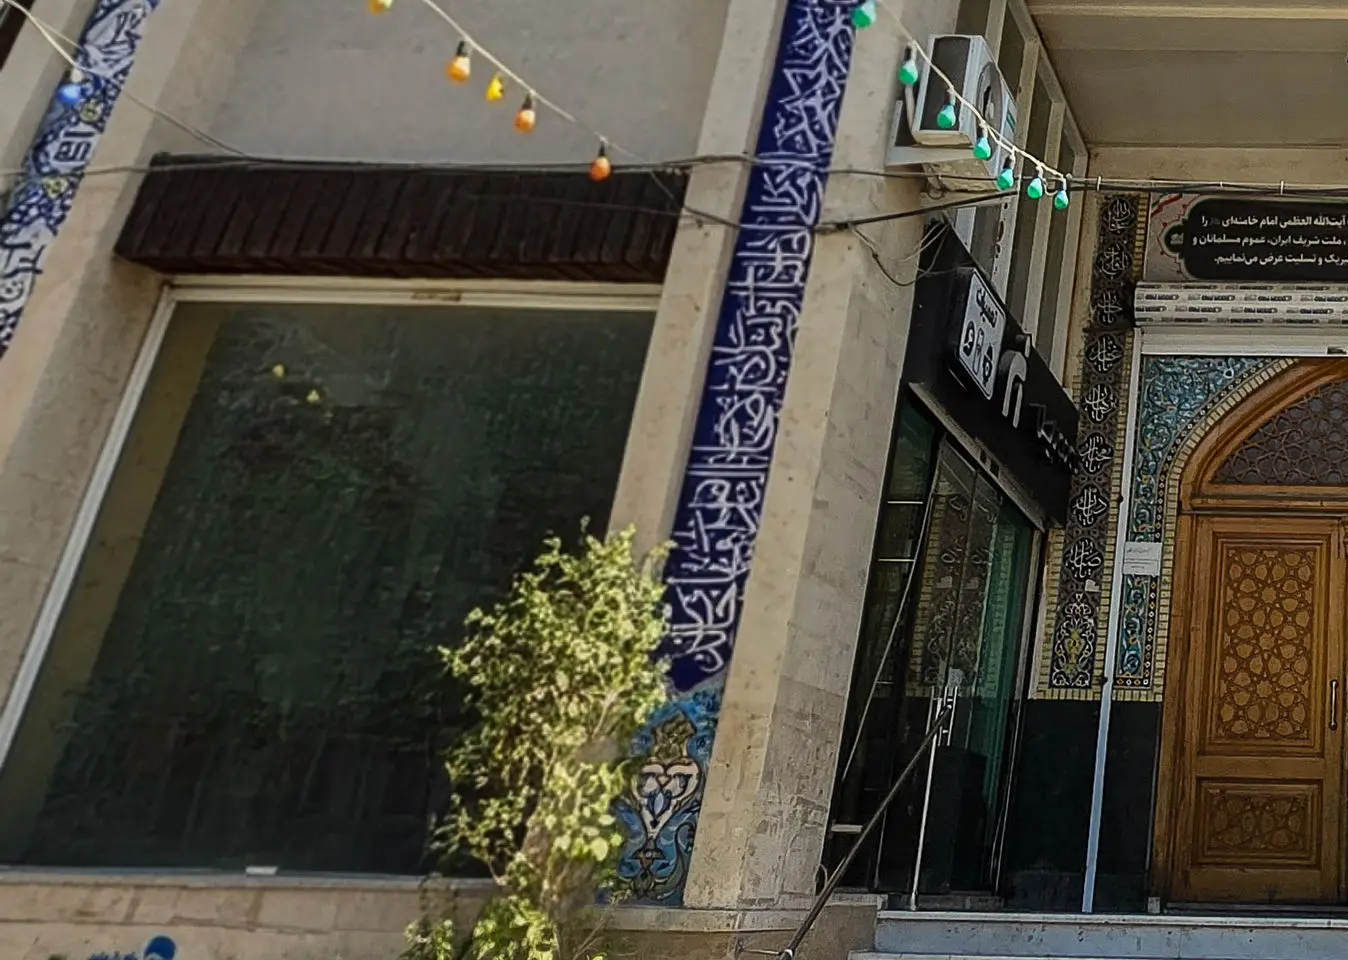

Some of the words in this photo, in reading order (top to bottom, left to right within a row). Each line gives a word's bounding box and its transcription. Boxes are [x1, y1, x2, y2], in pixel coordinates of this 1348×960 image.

[1260, 214, 1279, 230] امام
[1199, 234, 1240, 247] مسلمانان
[1241, 235, 1266, 248] عموم
[1292, 235, 1320, 248] شریف
[1259, 253, 1283, 267] عرض
[1284, 253, 1317, 265] تسلیت
